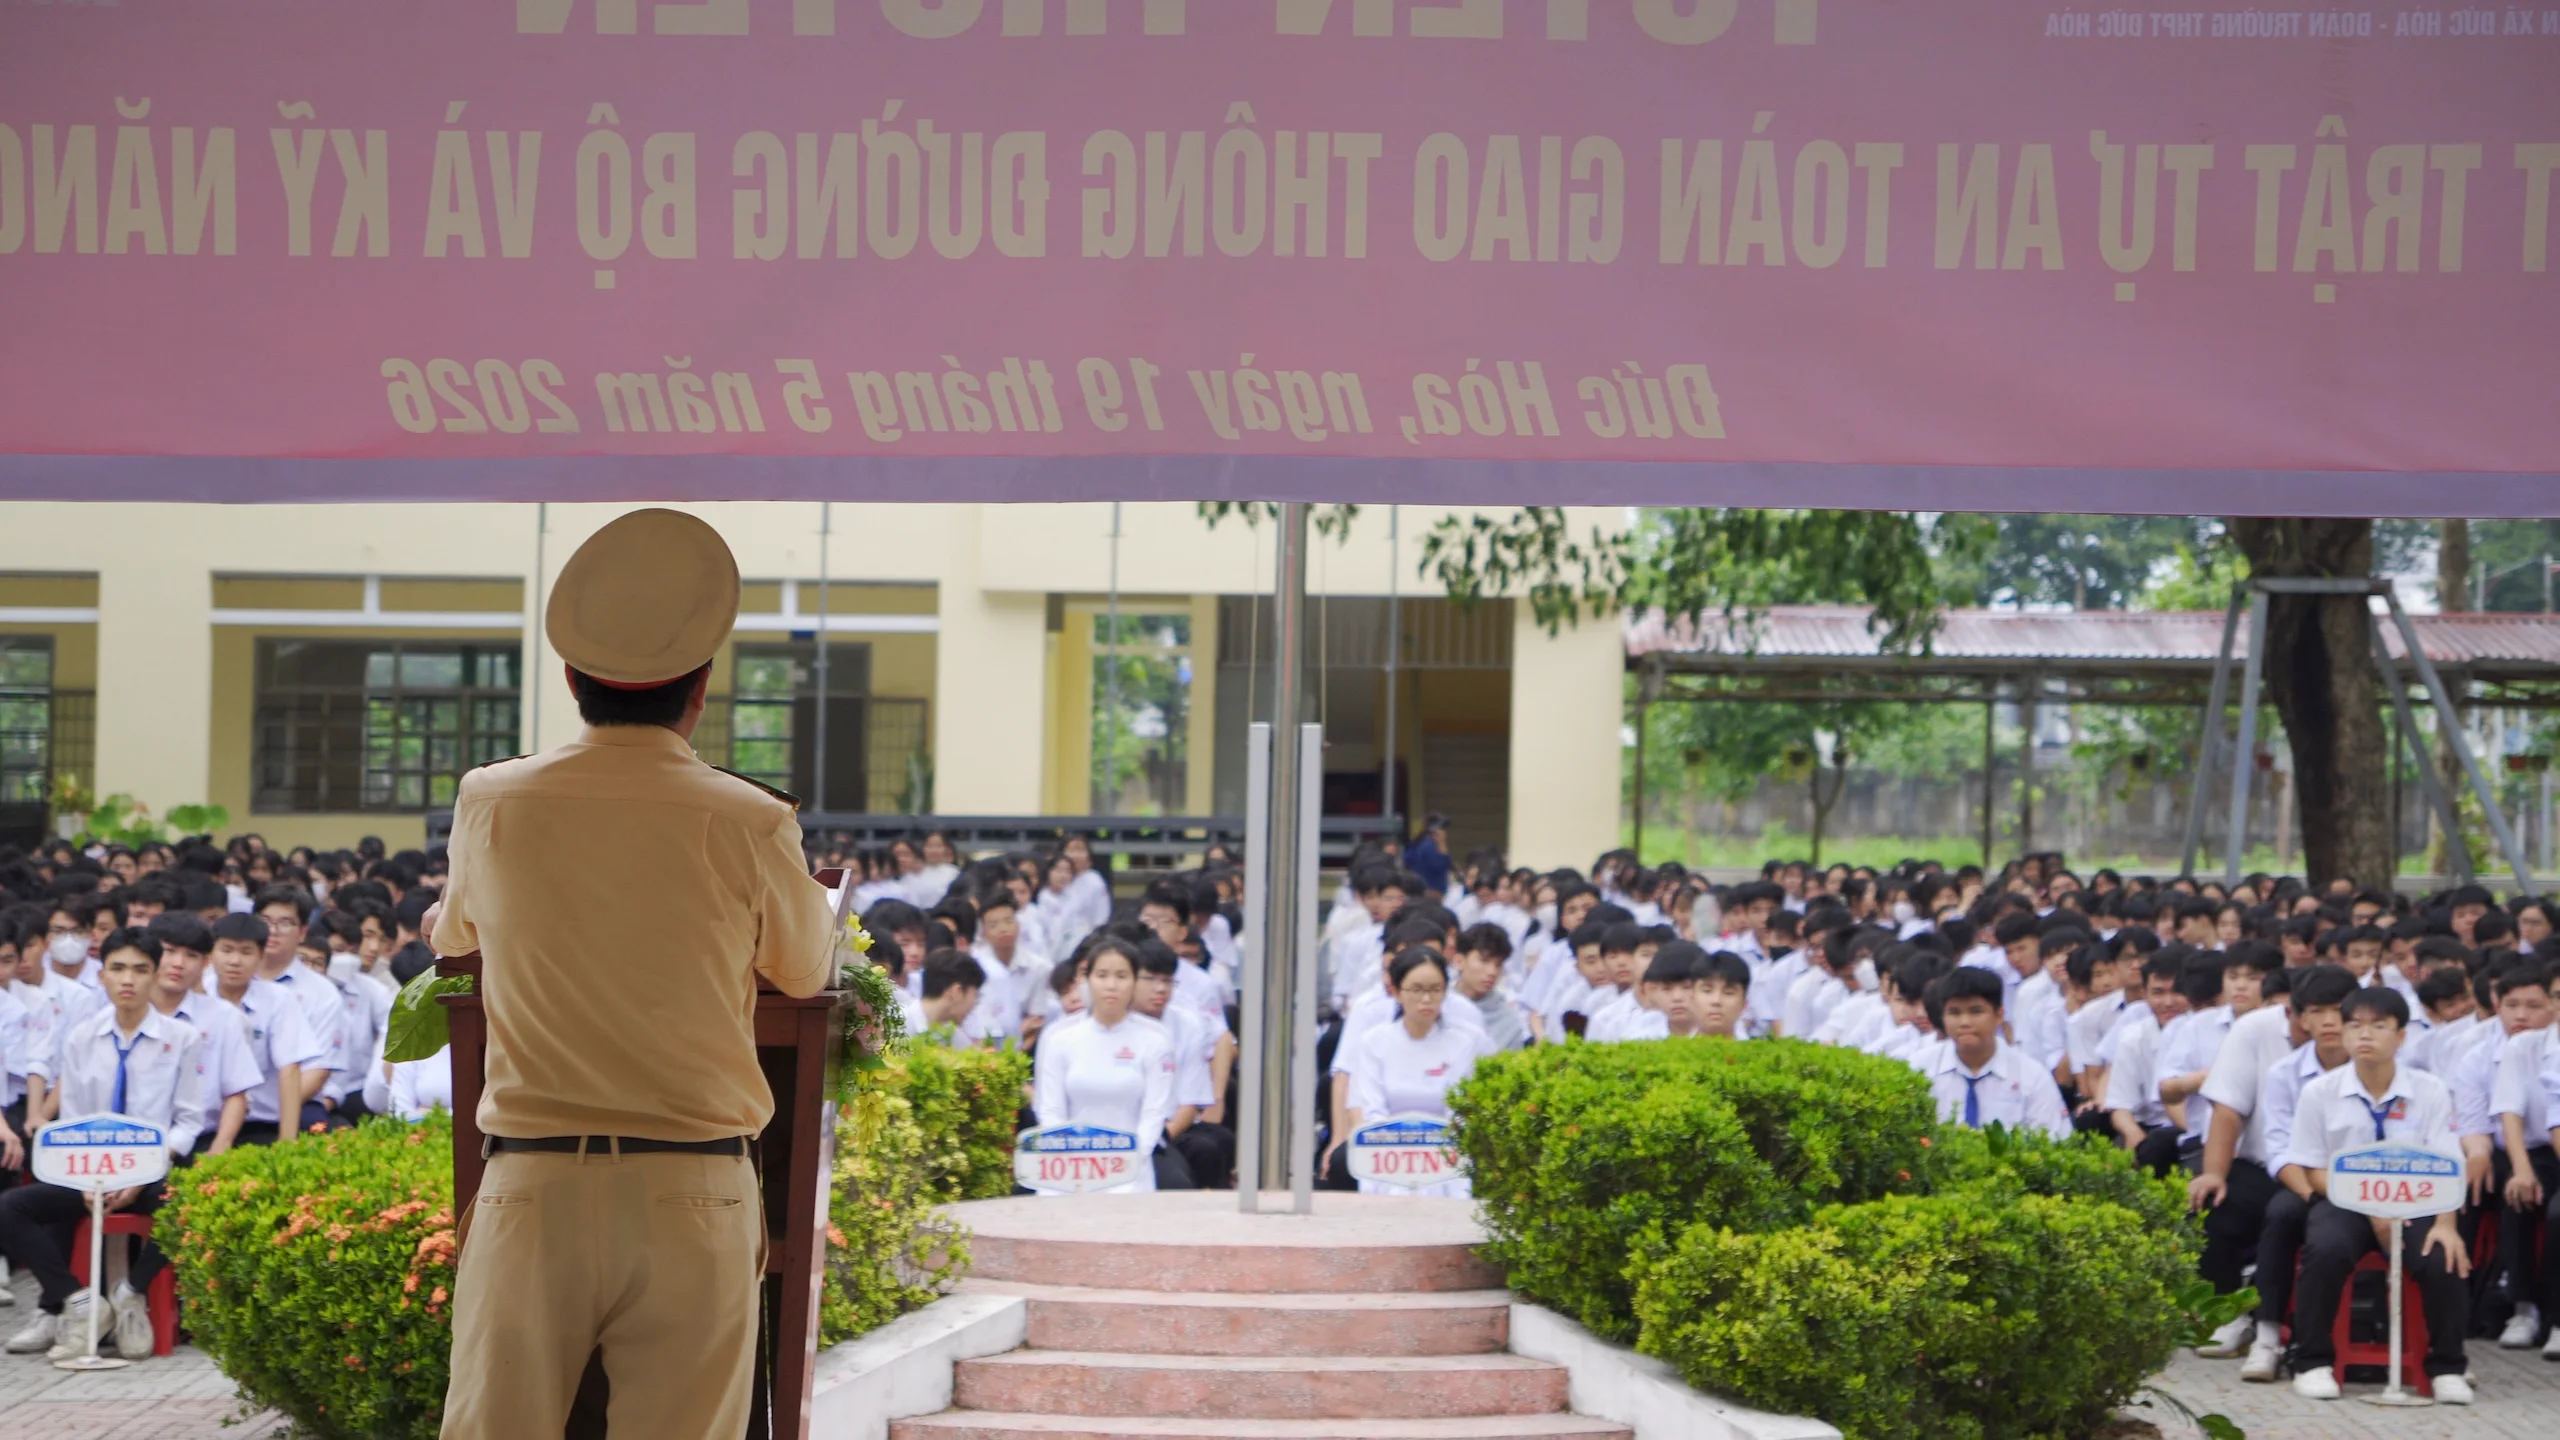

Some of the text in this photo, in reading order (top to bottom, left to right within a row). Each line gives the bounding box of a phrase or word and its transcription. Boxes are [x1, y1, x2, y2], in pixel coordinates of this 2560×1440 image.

[65, 1152, 137, 1176] 11A5
[1037, 1156, 1126, 1181] 10TN2
[2358, 1179, 2434, 1203] 10A2
